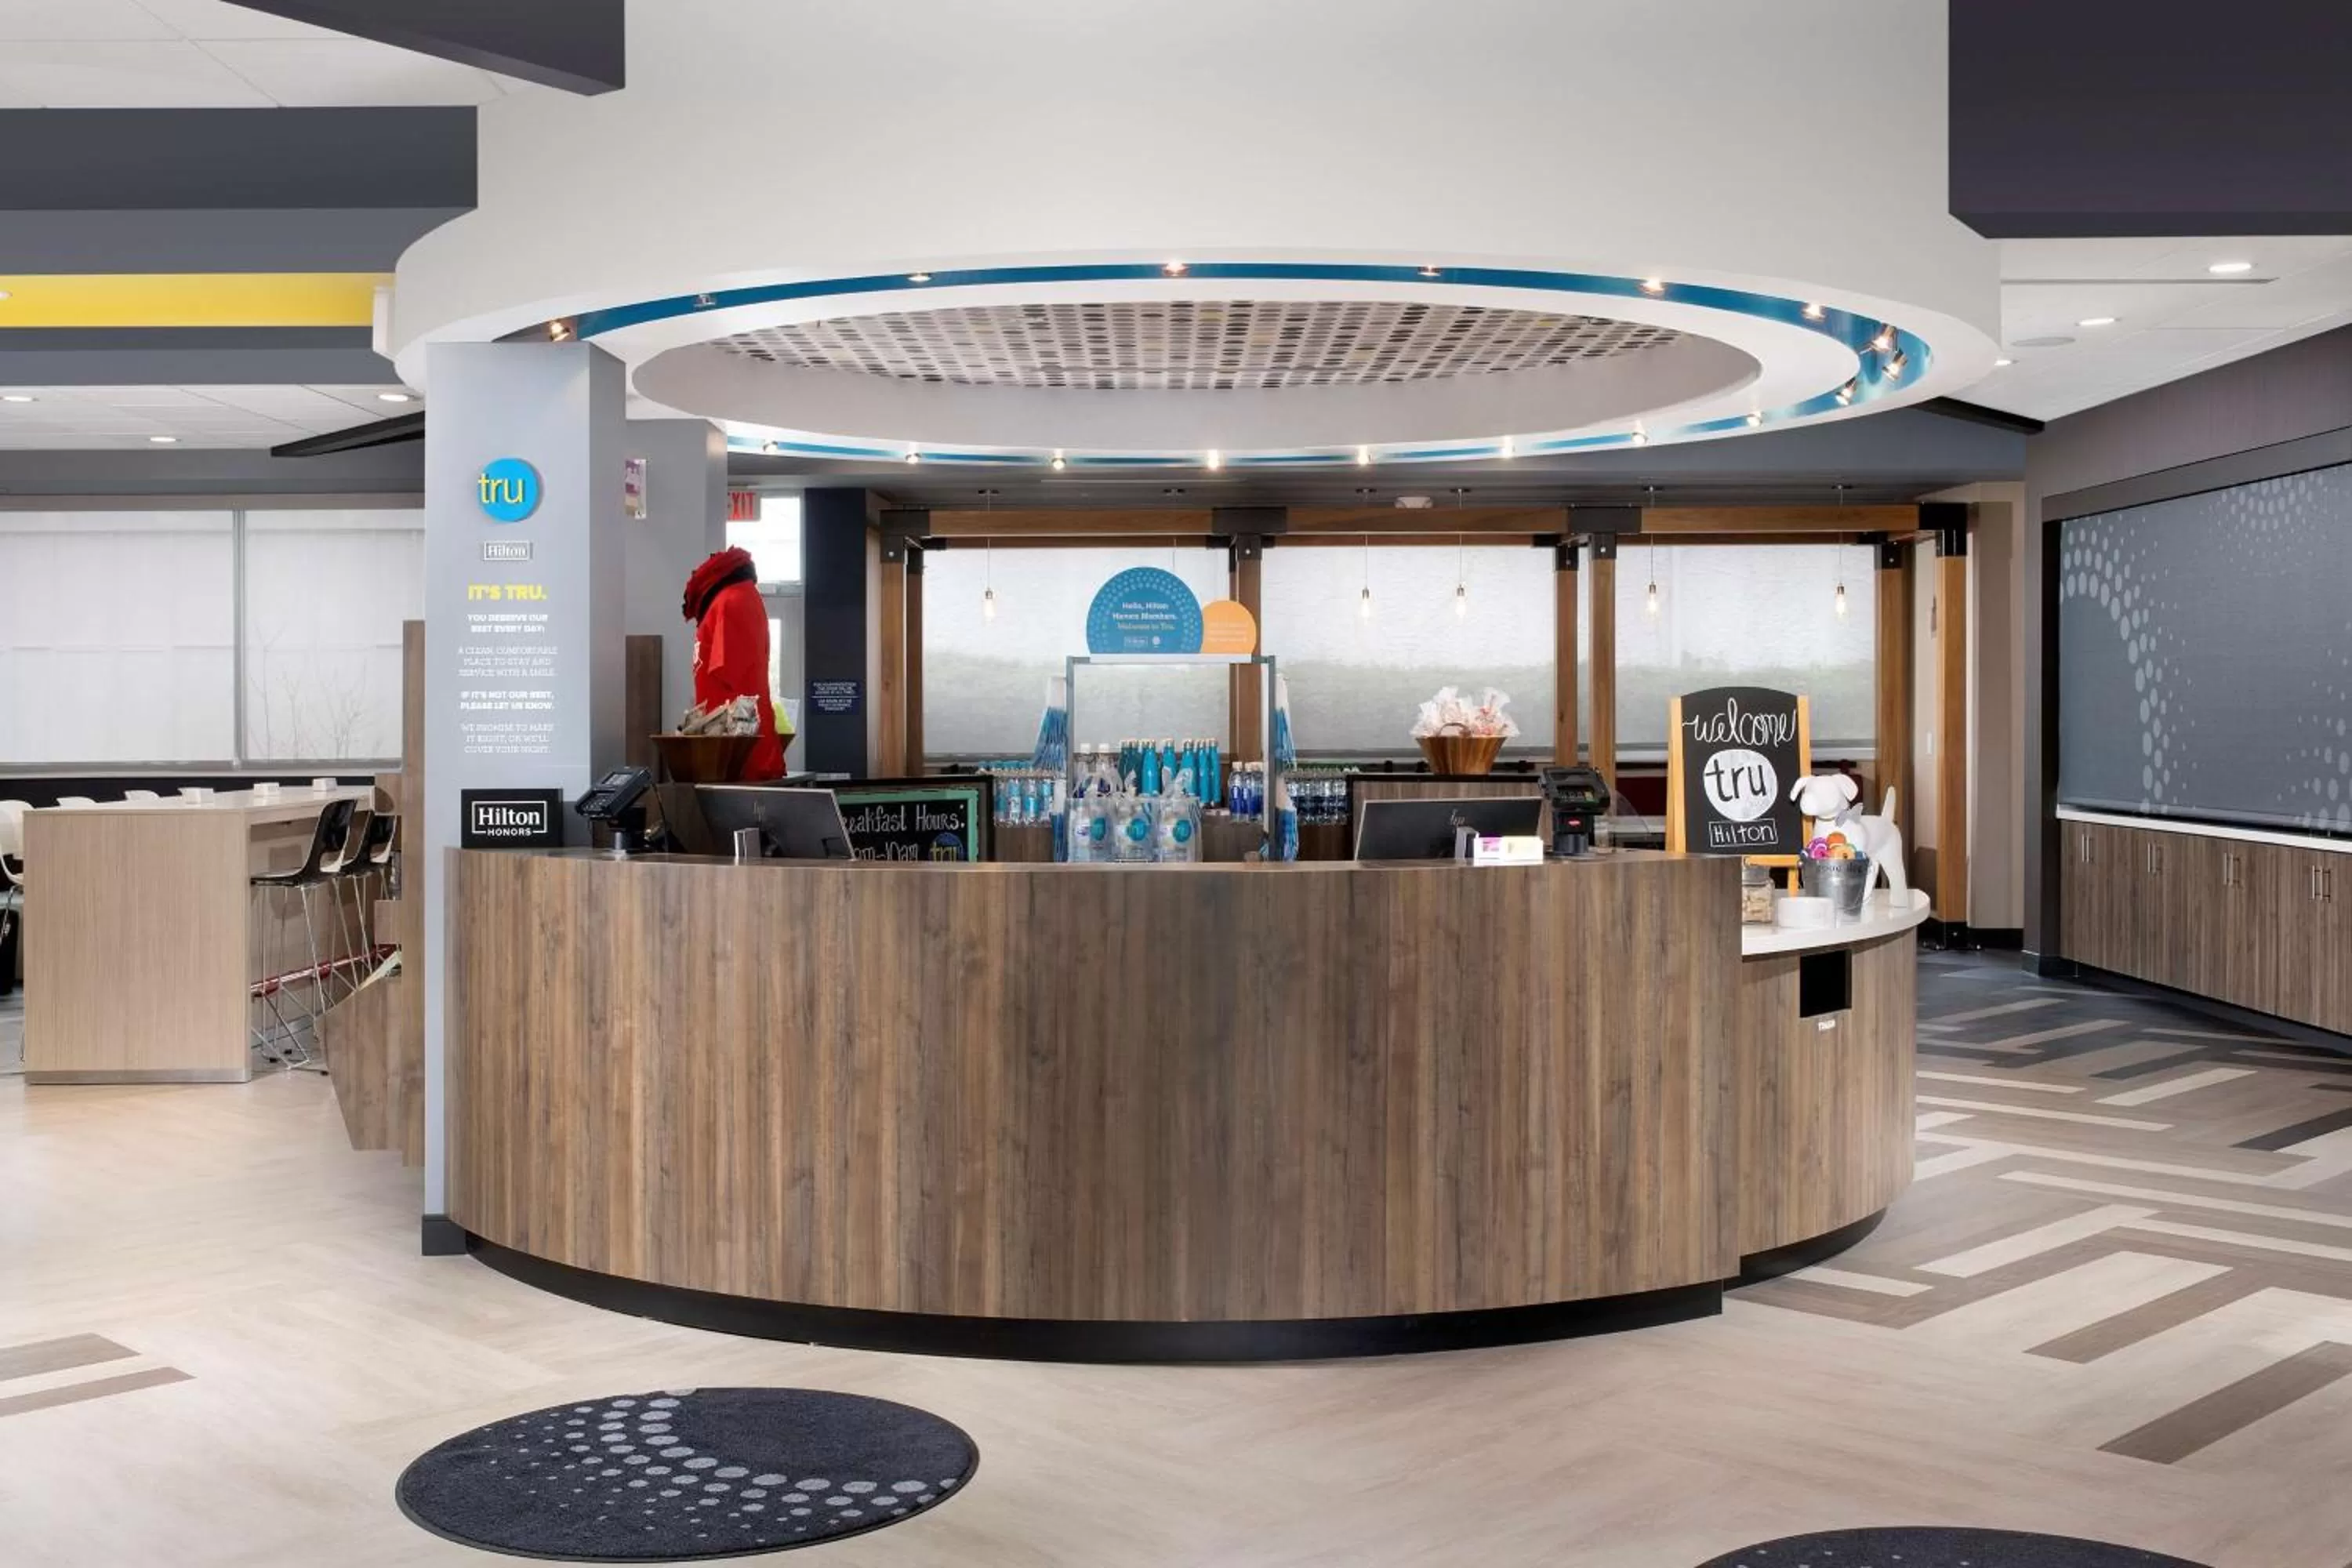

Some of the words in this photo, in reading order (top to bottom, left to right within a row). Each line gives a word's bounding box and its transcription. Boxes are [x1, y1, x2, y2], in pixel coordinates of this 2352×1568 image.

[478, 473, 524, 503] tru
[728, 491, 757, 521] XIT
[488, 544, 526, 557] Hilton
[468, 583, 502, 601] IT'S
[505, 583, 547, 601] TRU.
[1682, 697, 1797, 747] welcome
[1705, 759, 1767, 802] tru
[477, 807, 540, 826] Hilton
[487, 827, 532, 837] HONORS
[1713, 824, 1775, 844] Hilton
